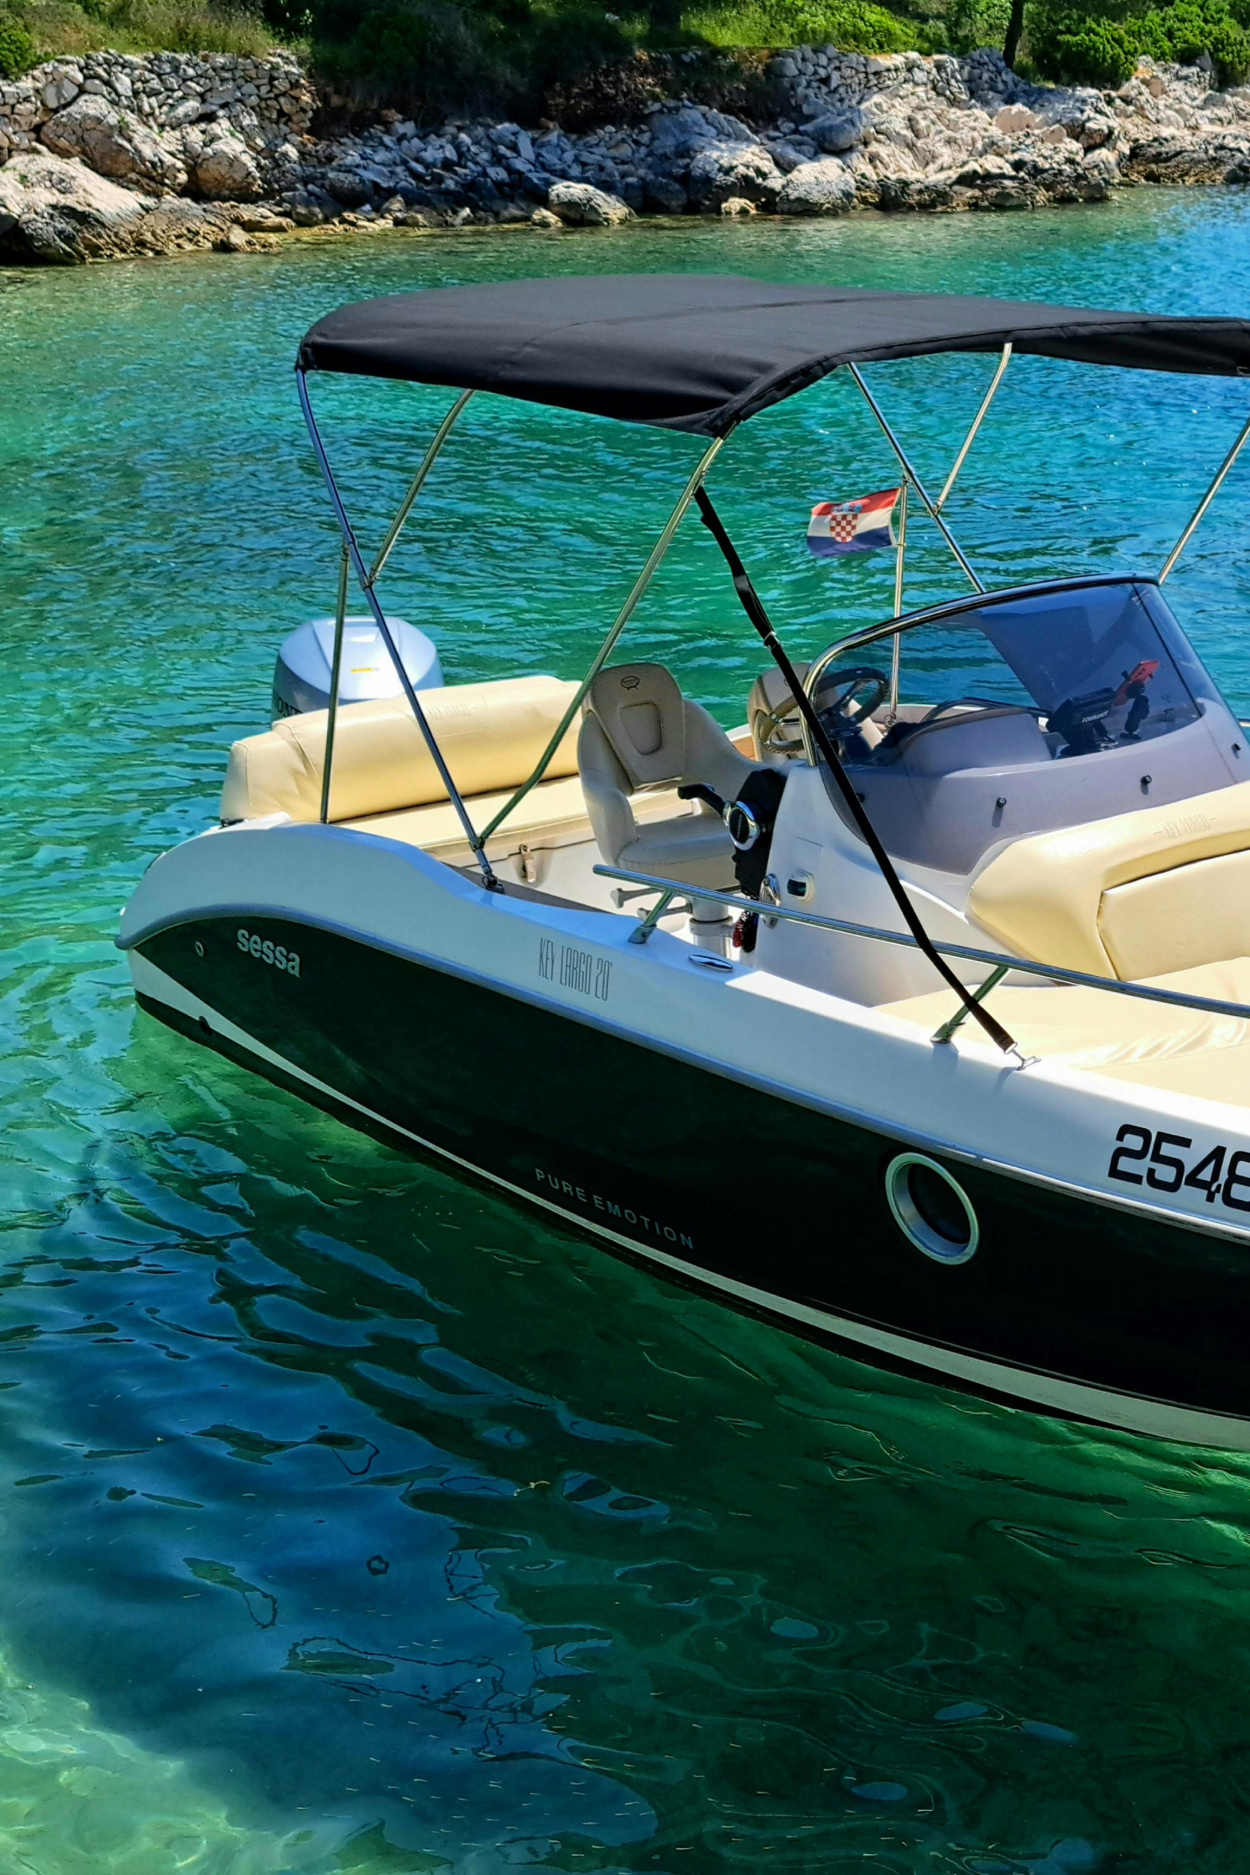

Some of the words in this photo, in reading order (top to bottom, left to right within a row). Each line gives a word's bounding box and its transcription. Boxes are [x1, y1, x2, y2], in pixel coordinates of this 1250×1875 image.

[236, 928, 301, 978] sessa
[538, 937, 555, 981] KEY
[559, 945, 593, 995] LARGO
[534, 1167, 588, 1203] PURE
[592, 1193, 695, 1250] EMOTION
